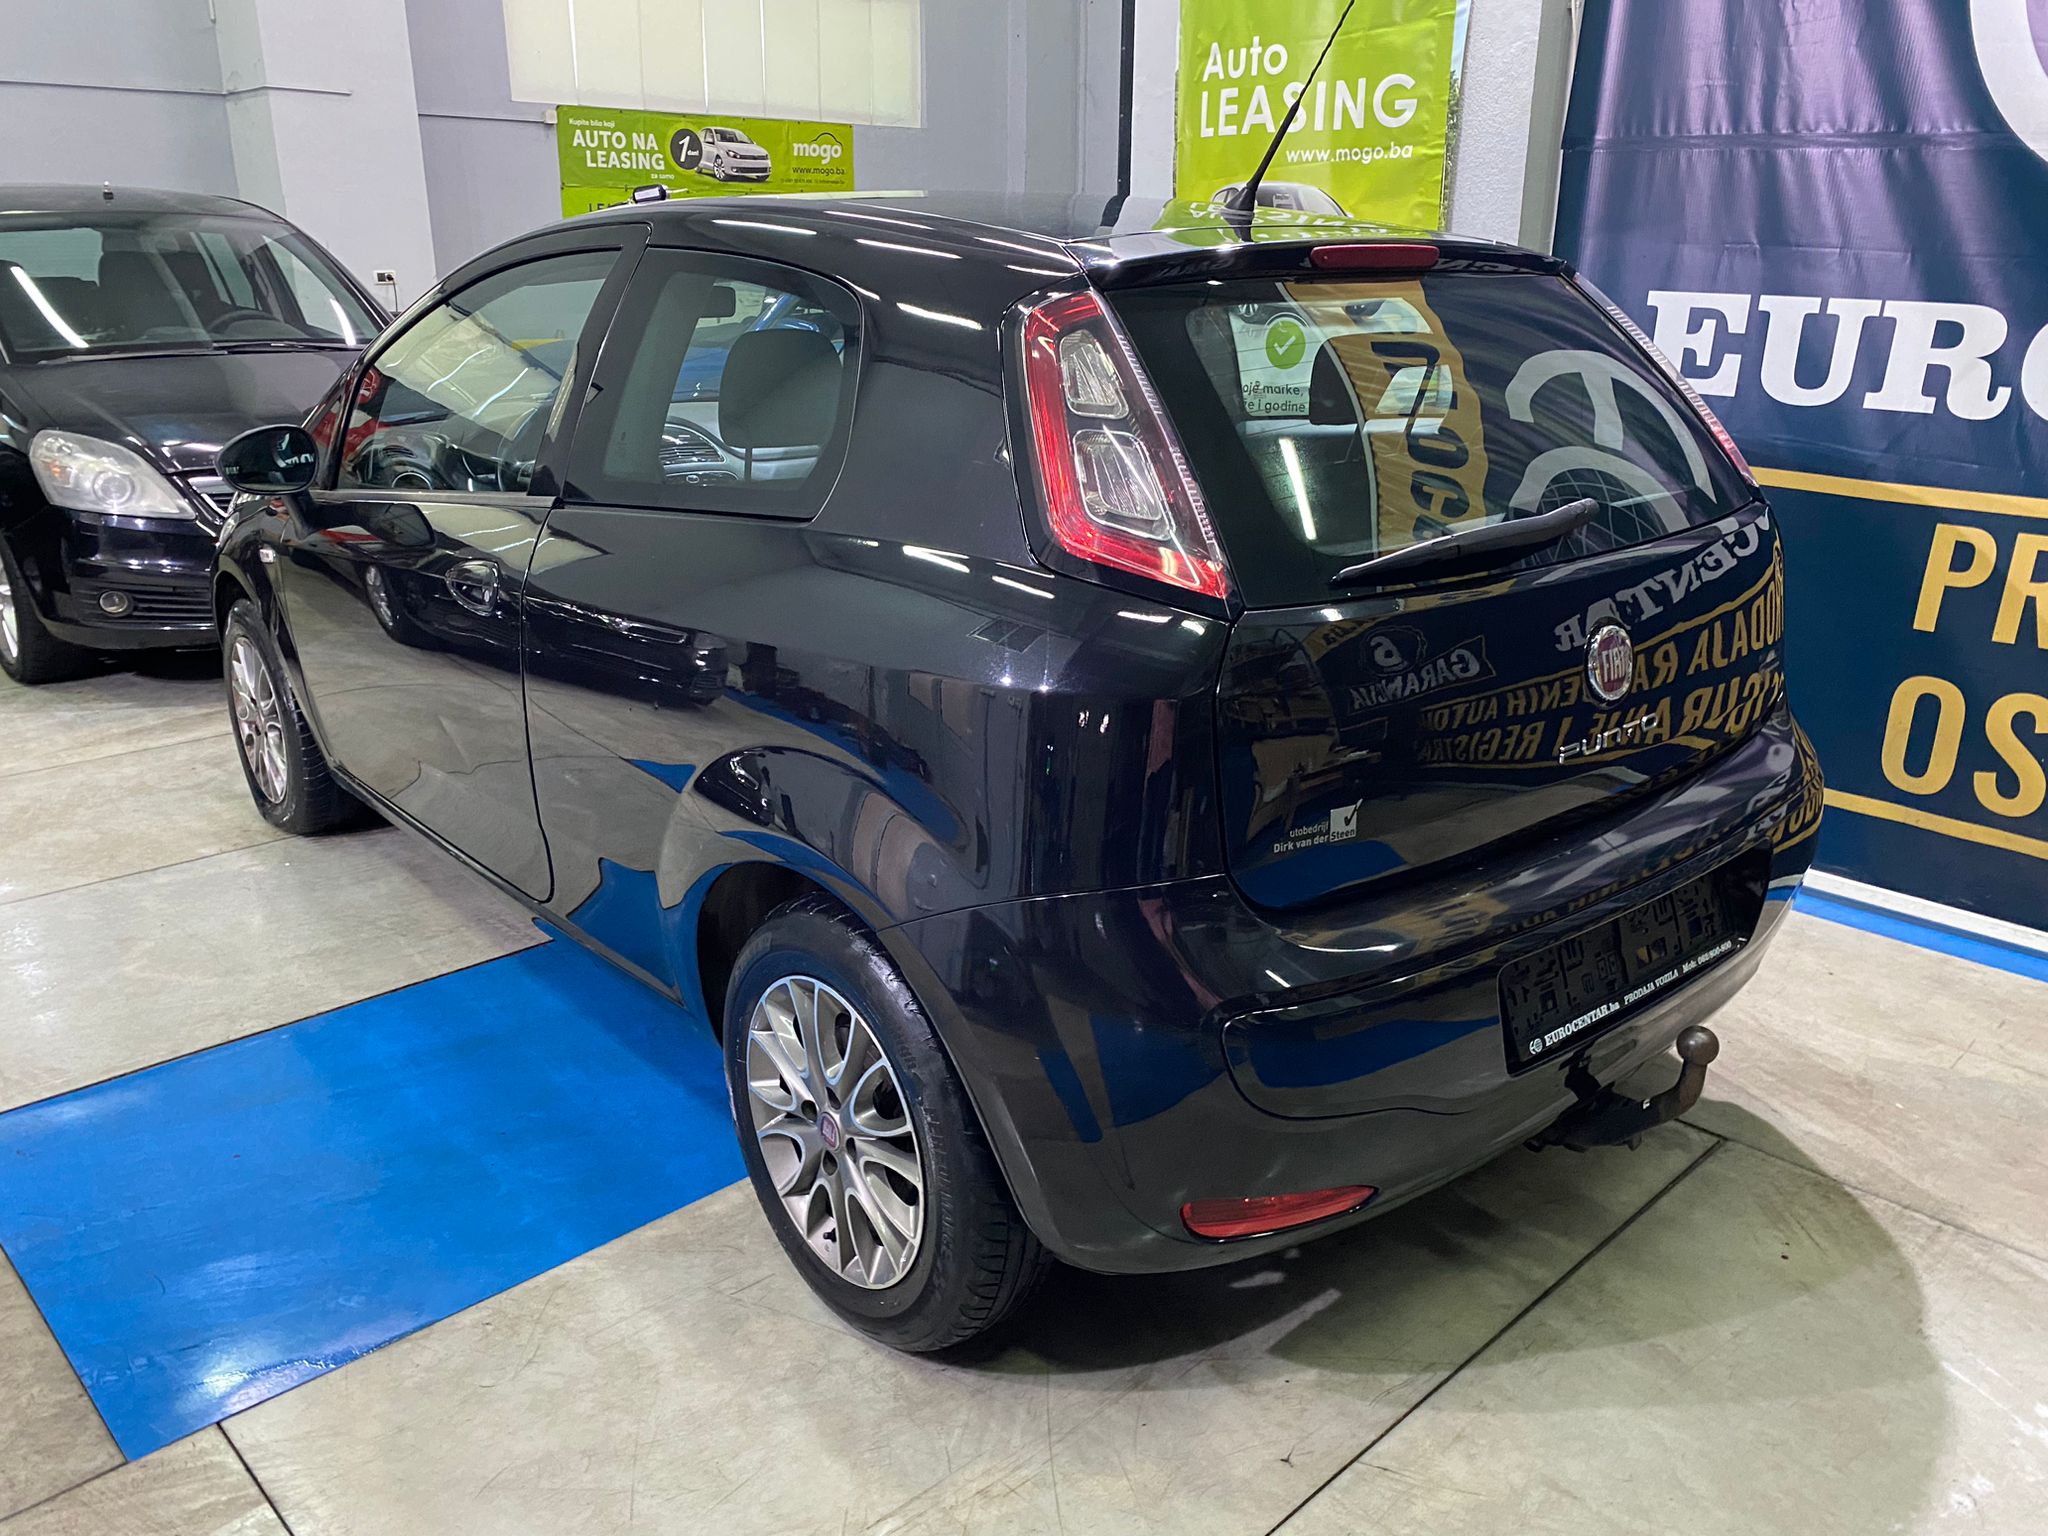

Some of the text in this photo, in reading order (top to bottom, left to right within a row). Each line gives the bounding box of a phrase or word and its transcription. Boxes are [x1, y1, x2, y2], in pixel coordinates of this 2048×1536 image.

[1202, 36, 1288, 82] Auto
[1200, 73, 1418, 138] LEASING
[573, 129, 659, 150] AUTO NA
[679, 135, 691, 162] 1
[586, 150, 665, 170] LEASING
[793, 143, 842, 165] mogo
[1286, 142, 1413, 165] www.mogo.ba
[792, 166, 845, 176] www.mogo.ba
[1263, 384, 1304, 397] marke,
[1264, 400, 1306, 413] godine
[1601, 645, 1627, 683] FIAT
[1880, 675, 2048, 818] OS
[1273, 829, 1355, 853] Dirk van der Steen
[1544, 1001, 1620, 1047] EUROCENTAR.ba
[1623, 981, 1655, 1006] PRODAJA
